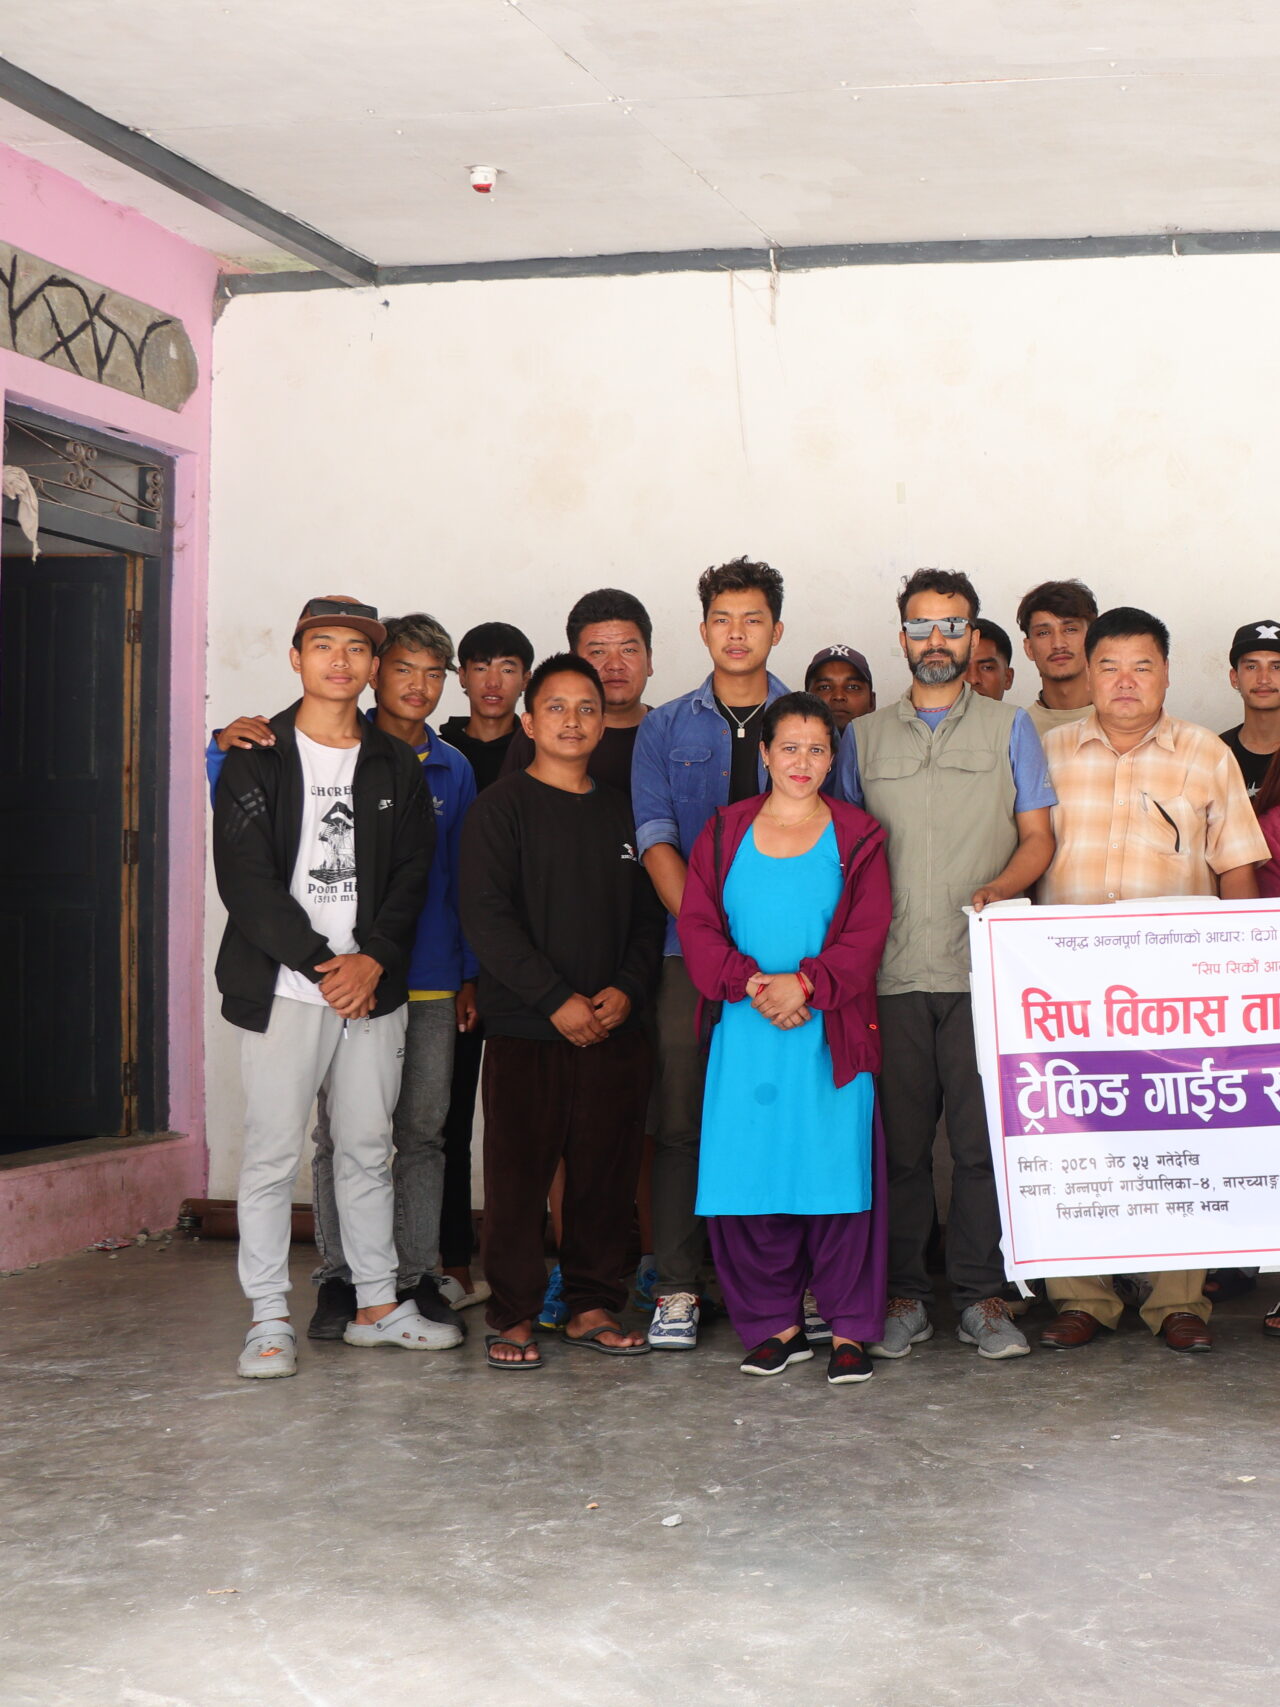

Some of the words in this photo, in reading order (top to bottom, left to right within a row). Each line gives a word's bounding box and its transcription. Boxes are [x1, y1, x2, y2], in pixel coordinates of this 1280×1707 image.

[311, 785, 354, 797] HORE
[308, 883, 338, 894] Poon
[1093, 930, 1141, 949] अन्नपूर्ण
[1144, 928, 1201, 946] निर्माणको
[1250, 925, 1278, 941] दिगो
[1021, 986, 1092, 1042] सिप
[1103, 983, 1230, 1038] विकास
[1015, 1057, 1131, 1134] ट्रेकिङ
[1140, 1056, 1250, 1124] गाईड
[1061, 1156, 1098, 1175] २०८१
[1104, 1152, 1127, 1170] जेठ
[1132, 1154, 1150, 1172] २५
[1155, 1149, 1202, 1169] गतेदेखि
[1064, 1176, 1115, 1199] अन्नपूर्ण
[1126, 1203, 1160, 1217] आमा
[1165, 1201, 1195, 1219] समूह
[1200, 1200, 1230, 1213] भवन
